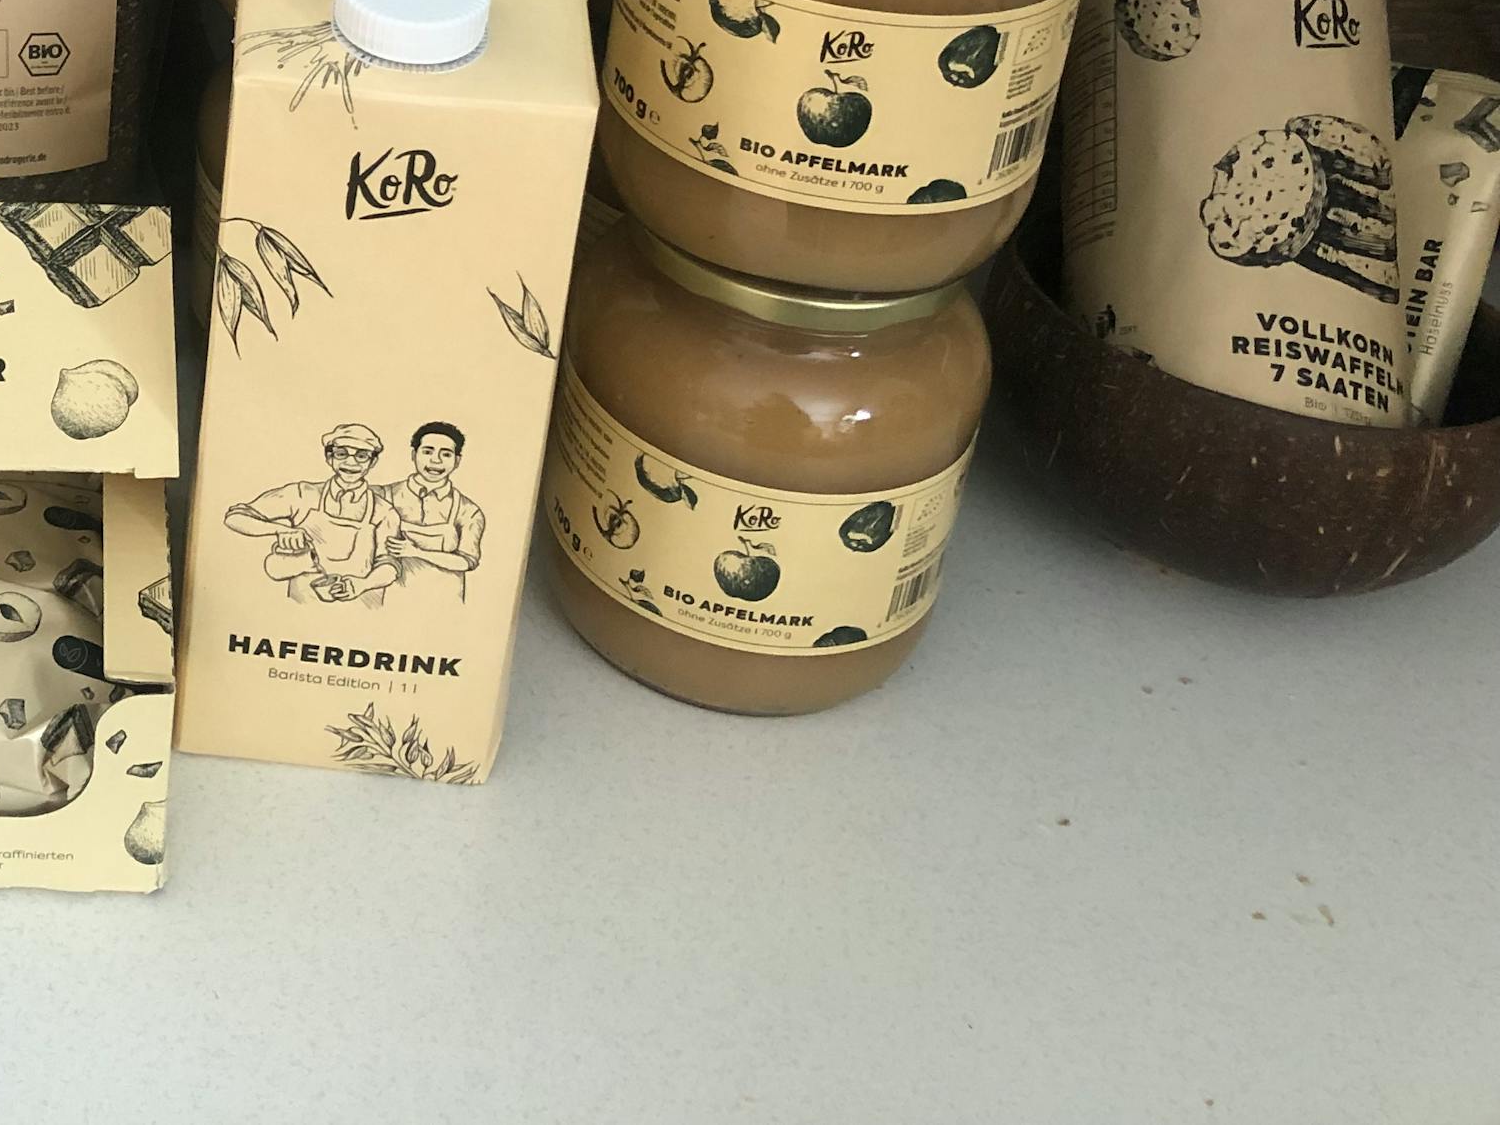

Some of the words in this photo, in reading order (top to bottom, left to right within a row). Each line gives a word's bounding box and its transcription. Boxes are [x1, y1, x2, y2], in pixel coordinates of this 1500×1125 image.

[28, 44, 64, 61] BIO
[819, 30, 875, 64] KoRo
[612, 66, 635, 106] 700
[635, 101, 648, 121] g
[739, 137, 775, 159] BIO
[779, 147, 909, 179] APFELMARK
[755, 162, 787, 181] ohne
[789, 171, 839, 190] Zusätze
[849, 181, 872, 193] 700
[875, 184, 884, 195] g
[344, 147, 458, 221] KoRo
[1415, 239, 1443, 283] BAR
[1256, 312, 1394, 367] VOLLKORN
[1269, 363, 1285, 383] 7
[1296, 367, 1389, 413] SAATEN
[551, 496, 571, 538] 700
[571, 534, 582, 552] g
[733, 504, 781, 532] KoRo
[662, 584, 695, 605] BIO
[698, 599, 815, 627] APFELMARK
[677, 607, 705, 624] ohne
[707, 617, 752, 635] Zusätze
[760, 628, 782, 639] 700
[785, 631, 792, 640] g
[227, 633, 463, 677] HAFERDRINK
[267, 667, 323, 686] Barista
[326, 674, 381, 692] Edition
[401, 682, 407, 693] 1
